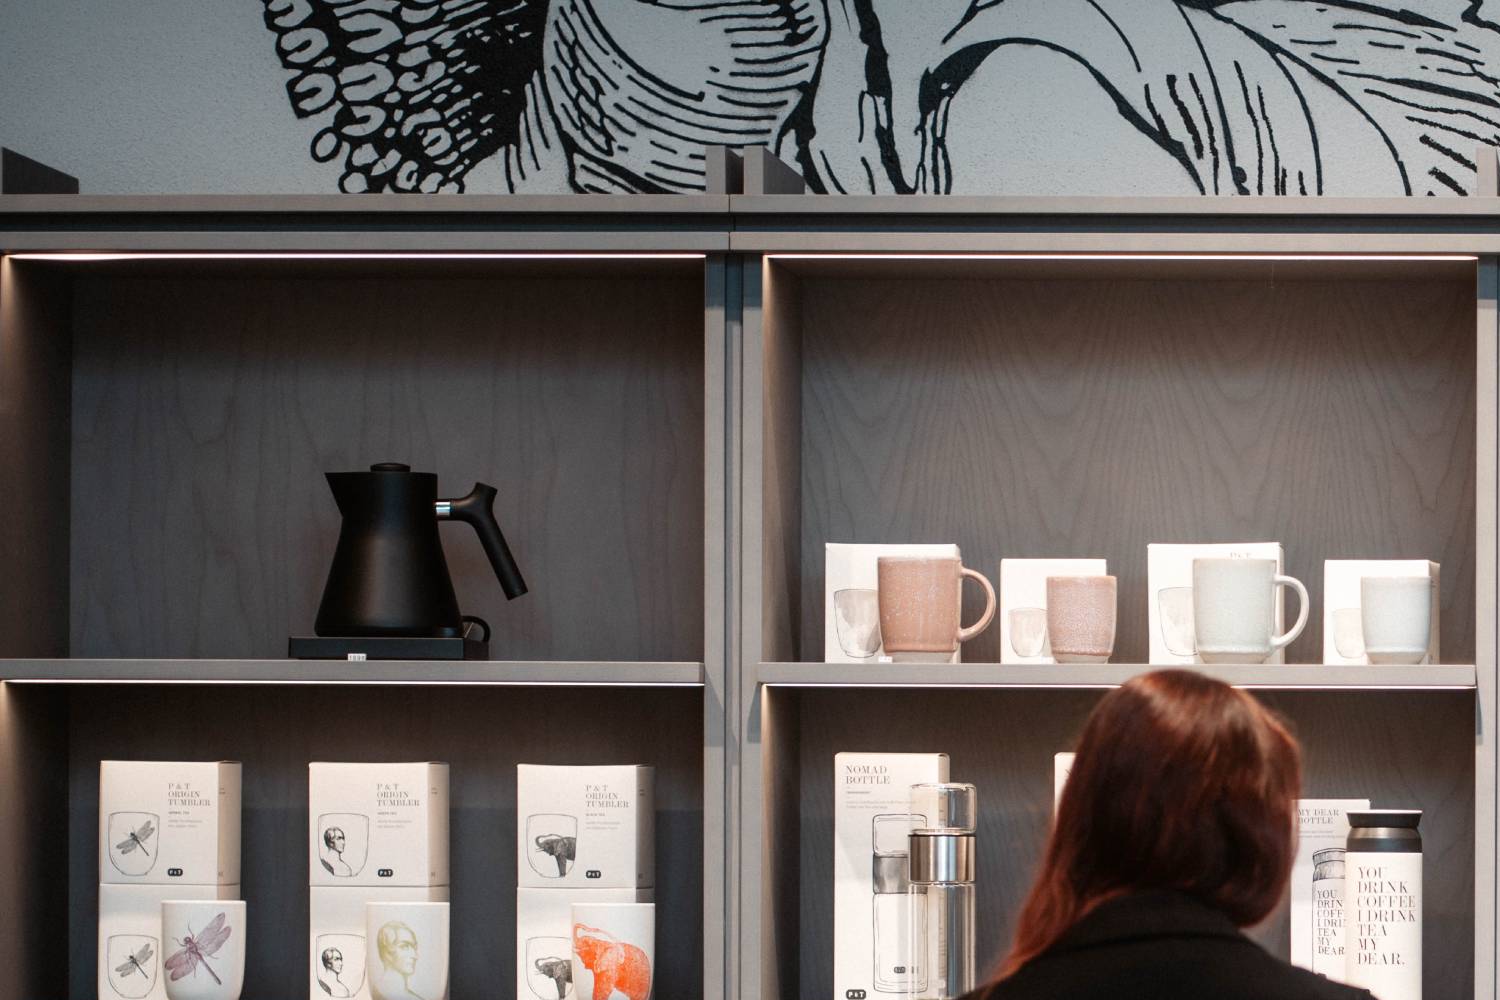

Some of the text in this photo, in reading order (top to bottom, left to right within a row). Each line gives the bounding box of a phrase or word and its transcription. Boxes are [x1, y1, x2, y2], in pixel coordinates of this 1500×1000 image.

[846, 765, 887, 774] NOMAD
[846, 776, 890, 784] BOTTLE
[1314, 808, 1339, 816] DEAR
[1358, 867, 1388, 879] YOU
[1358, 882, 1408, 893] DRINK
[1318, 890, 1337, 898] YOU
[1318, 900, 1343, 908] DRIN
[1358, 896, 1416, 908] COFFEE
[1318, 909, 1343, 918] COFF
[1368, 910, 1416, 922] DRINK
[1323, 919, 1345, 927] DRI
[1317, 928, 1336, 936] TEA
[1358, 924, 1388, 936] TEA
[1318, 937, 1331, 946] MY
[1359, 939, 1378, 950] MY
[1358, 953, 1405, 964] DEAR.
